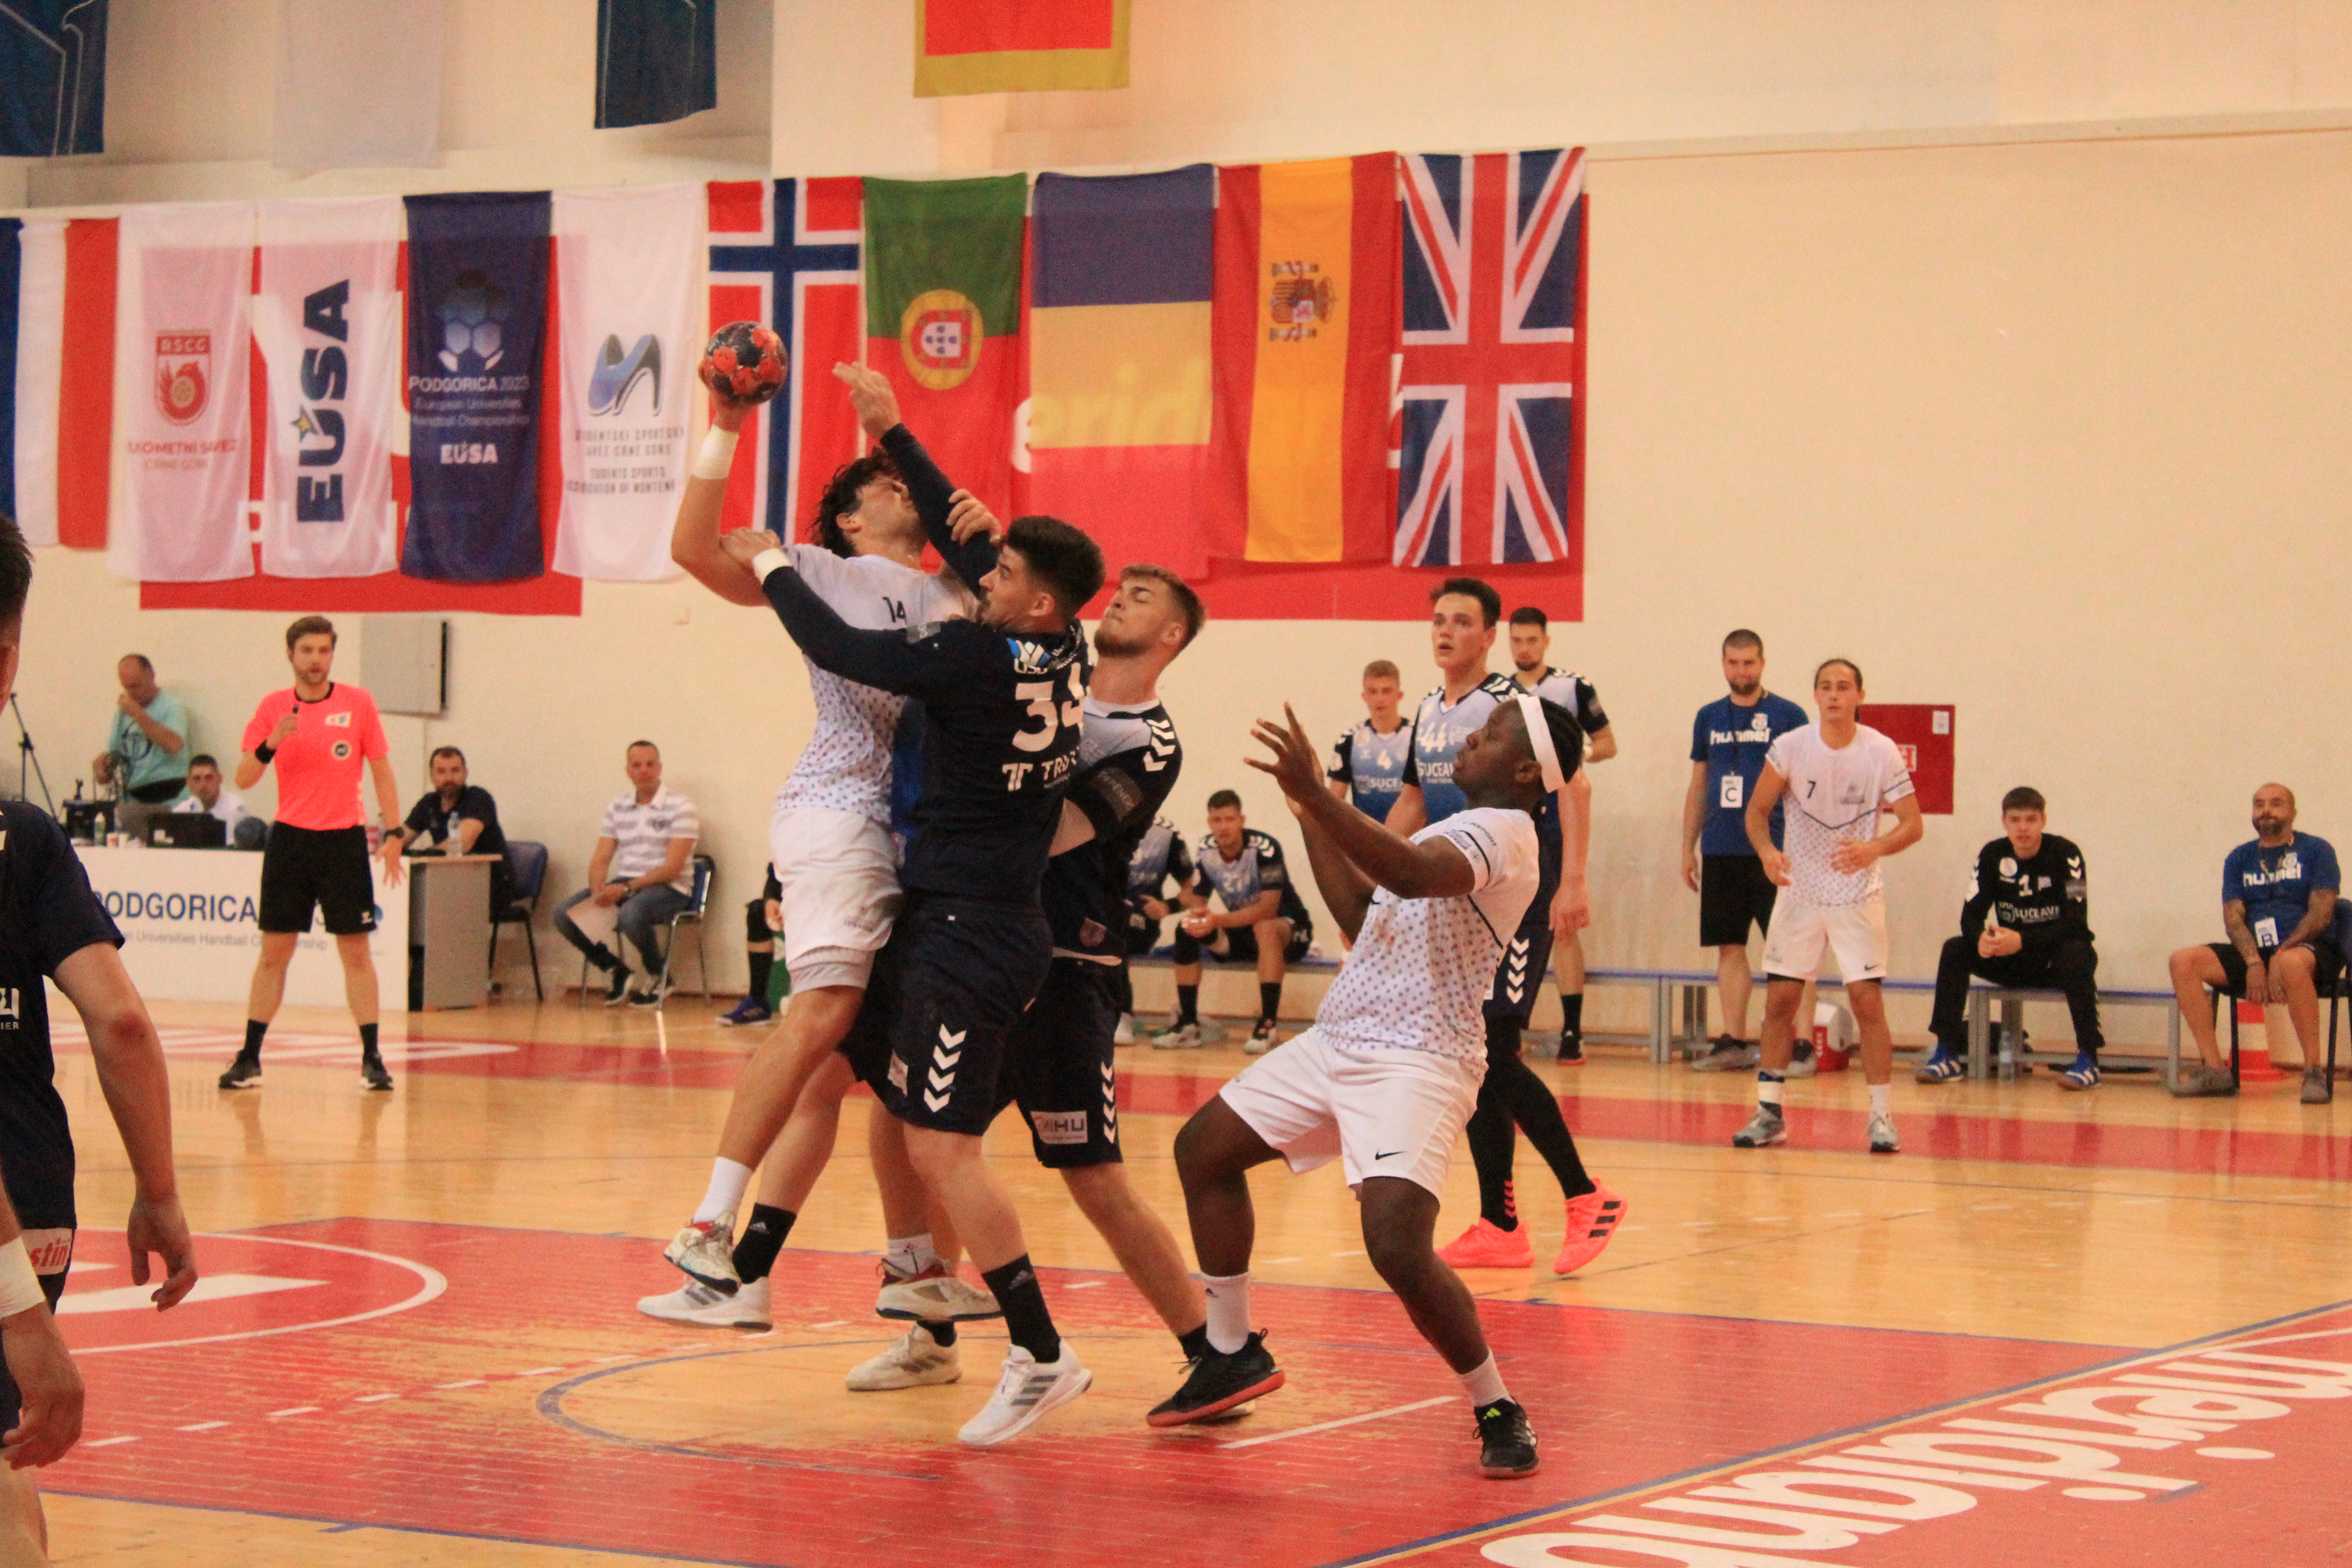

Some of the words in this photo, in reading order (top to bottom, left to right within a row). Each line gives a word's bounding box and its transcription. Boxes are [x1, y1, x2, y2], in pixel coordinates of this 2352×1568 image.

[408, 375, 498, 393] PODGORICA
[297, 279, 350, 522] EUSA
[440, 441, 498, 465] EUSA
[883, 596, 907, 624] 14
[1012, 662, 1086, 752] 34
[1377, 750, 1392, 769] 4
[1725, 787, 1738, 803] C
[1807, 780, 1817, 799] 7
[2019, 874, 2033, 897] 1
[200, 932, 248, 947] Handball
